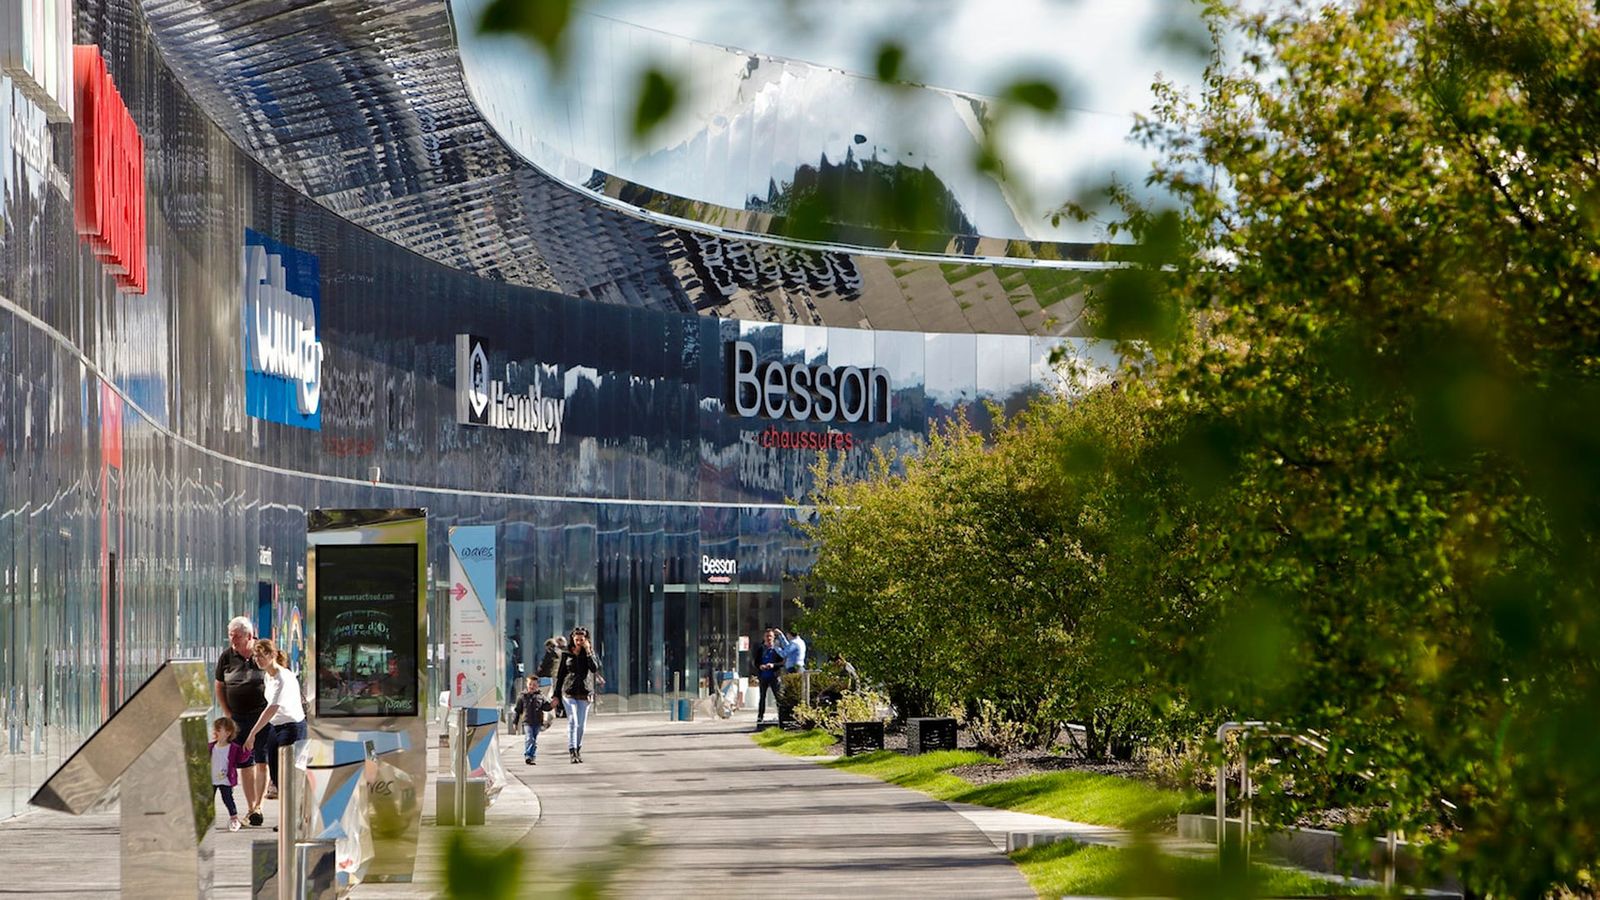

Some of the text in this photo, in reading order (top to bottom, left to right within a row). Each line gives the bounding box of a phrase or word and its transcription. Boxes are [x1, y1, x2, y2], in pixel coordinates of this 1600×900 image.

[733, 340, 892, 424] Besson
[763, 425, 853, 449] chaussures
[461, 546, 494, 558] waves
[702, 554, 737, 575] Besson
[367, 780, 394, 797] ves
